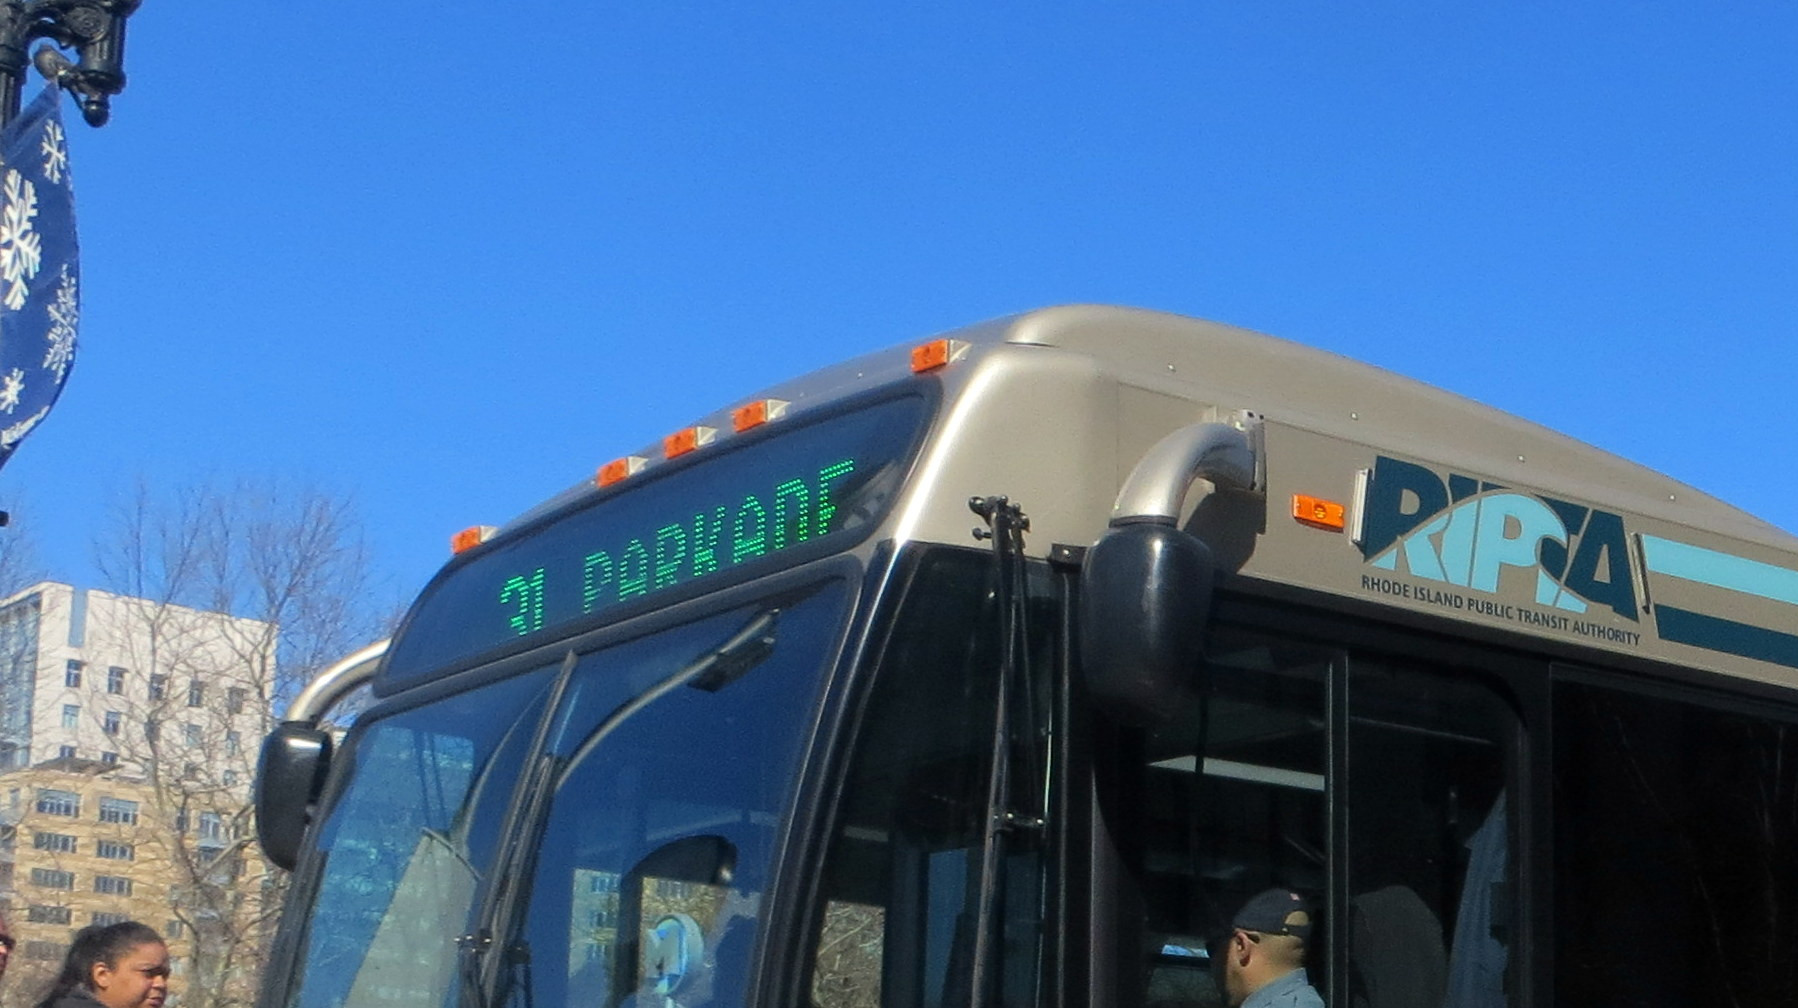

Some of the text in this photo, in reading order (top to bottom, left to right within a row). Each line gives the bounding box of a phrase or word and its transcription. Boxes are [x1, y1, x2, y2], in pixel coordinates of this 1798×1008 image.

[1362, 575, 1641, 646] RHODE ISLAND PUBLIC TRANSIT AUTHORITY
